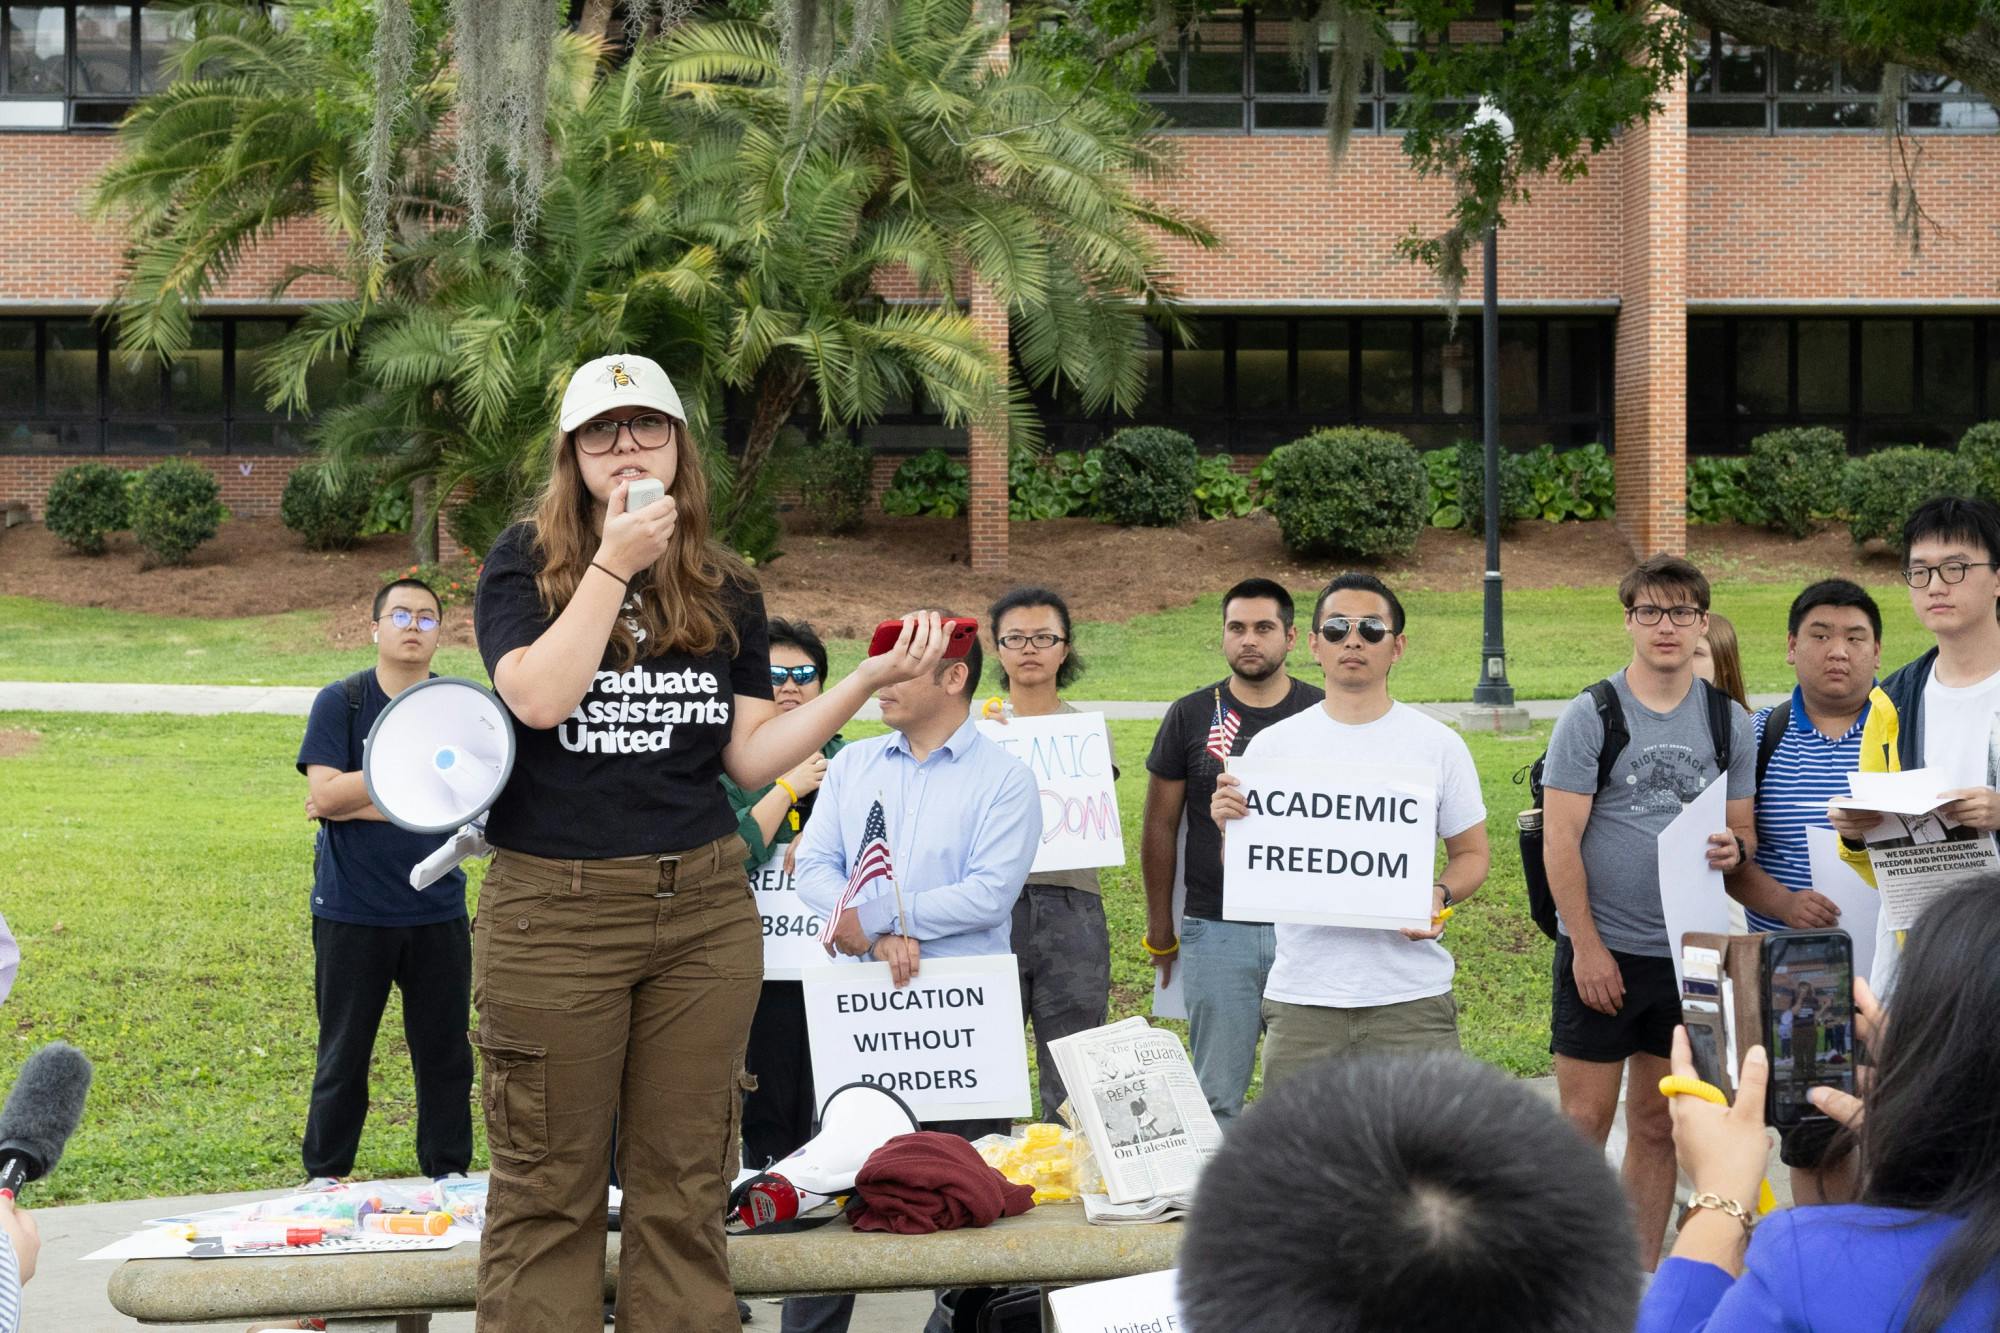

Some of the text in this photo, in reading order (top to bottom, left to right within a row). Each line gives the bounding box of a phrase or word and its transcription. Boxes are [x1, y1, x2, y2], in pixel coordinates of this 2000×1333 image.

[587, 665, 719, 695] raduate
[568, 695, 729, 725] Assistants
[558, 724, 674, 754] United
[1630, 751, 1657, 771] RIDE
[1678, 751, 1707, 774] PACK
[1039, 789, 1121, 845] DOM
[1246, 789, 1418, 824] ACADEMIC
[1248, 844, 1408, 879] FREEDOM
[1874, 850, 1995, 869] FREEDOM AND INTERNATIONAL
[1884, 842, 1979, 859] WE DESERVE ACADEMIC
[749, 869, 796, 891] REJE
[1887, 860, 1987, 877] INTELLIGENCE EXCHANGE
[836, 986, 984, 1013] EDUCATION
[853, 1028, 975, 1053] WITHOUT
[1111, 1045, 1130, 1054] The
[1134, 1047, 1185, 1066] Iguana
[1114, 1147, 1133, 1160] On
[1135, 1136, 1188, 1156] Palestine
[1166, 1314, 1177, 1331] F
